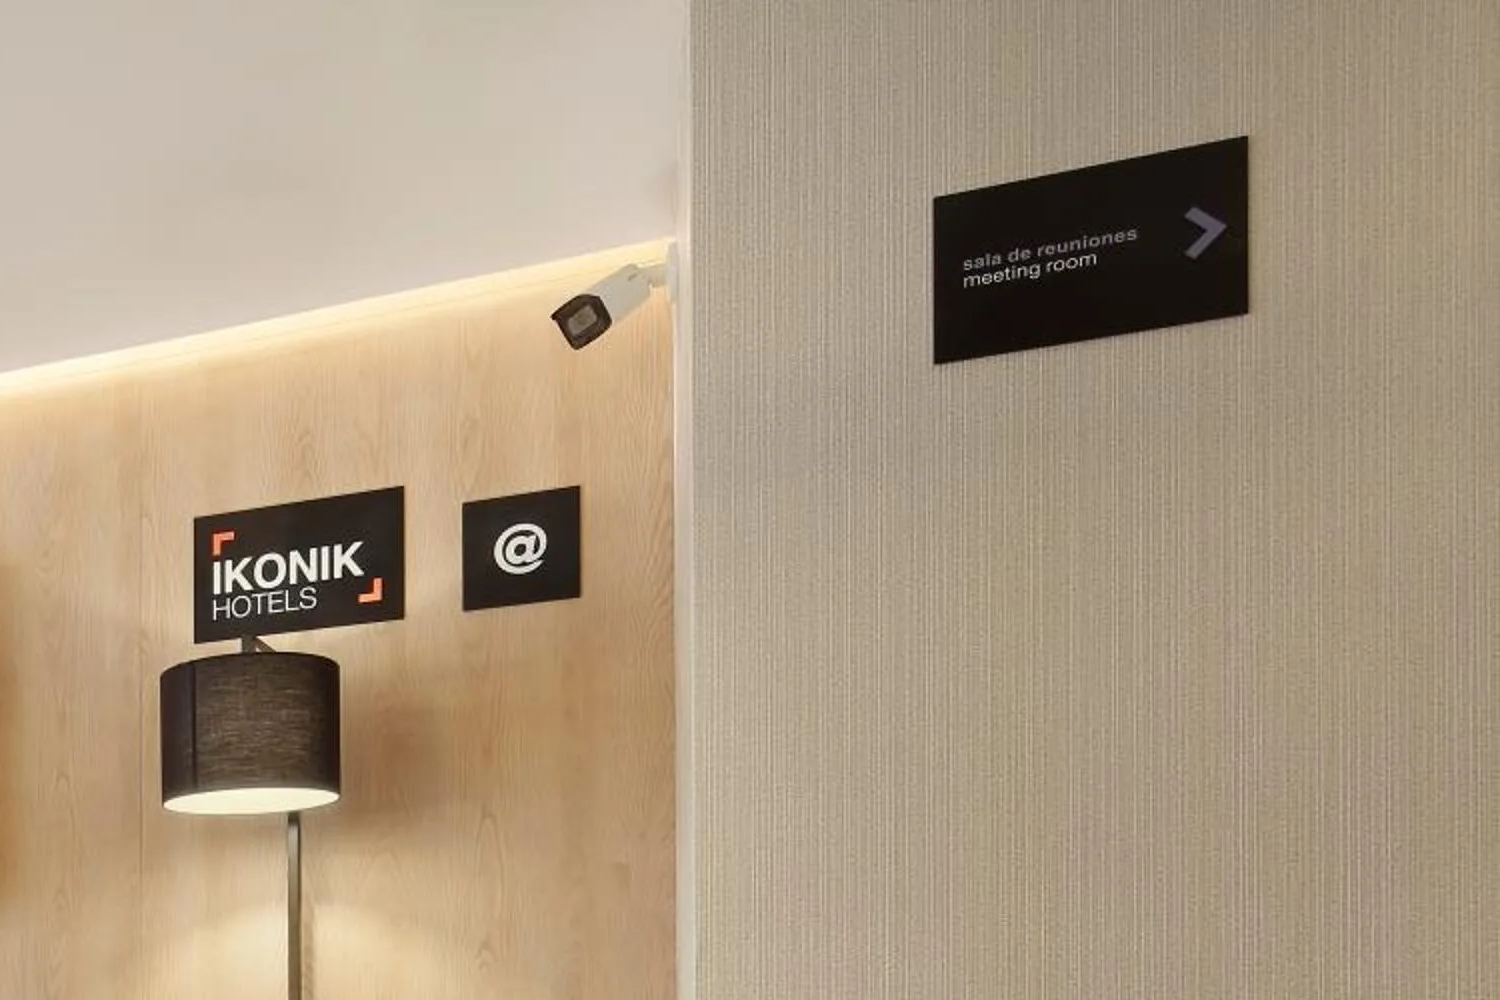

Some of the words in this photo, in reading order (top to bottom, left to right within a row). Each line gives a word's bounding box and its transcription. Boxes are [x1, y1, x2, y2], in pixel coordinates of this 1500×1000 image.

[963, 252, 1001, 271] sala
[1007, 246, 1031, 263] de
[1037, 228, 1138, 257] reuniones
[963, 263, 1041, 289] meeting
[1046, 252, 1098, 273] room
[212, 540, 366, 596] IKONIK
[211, 585, 318, 621] HOTELS
